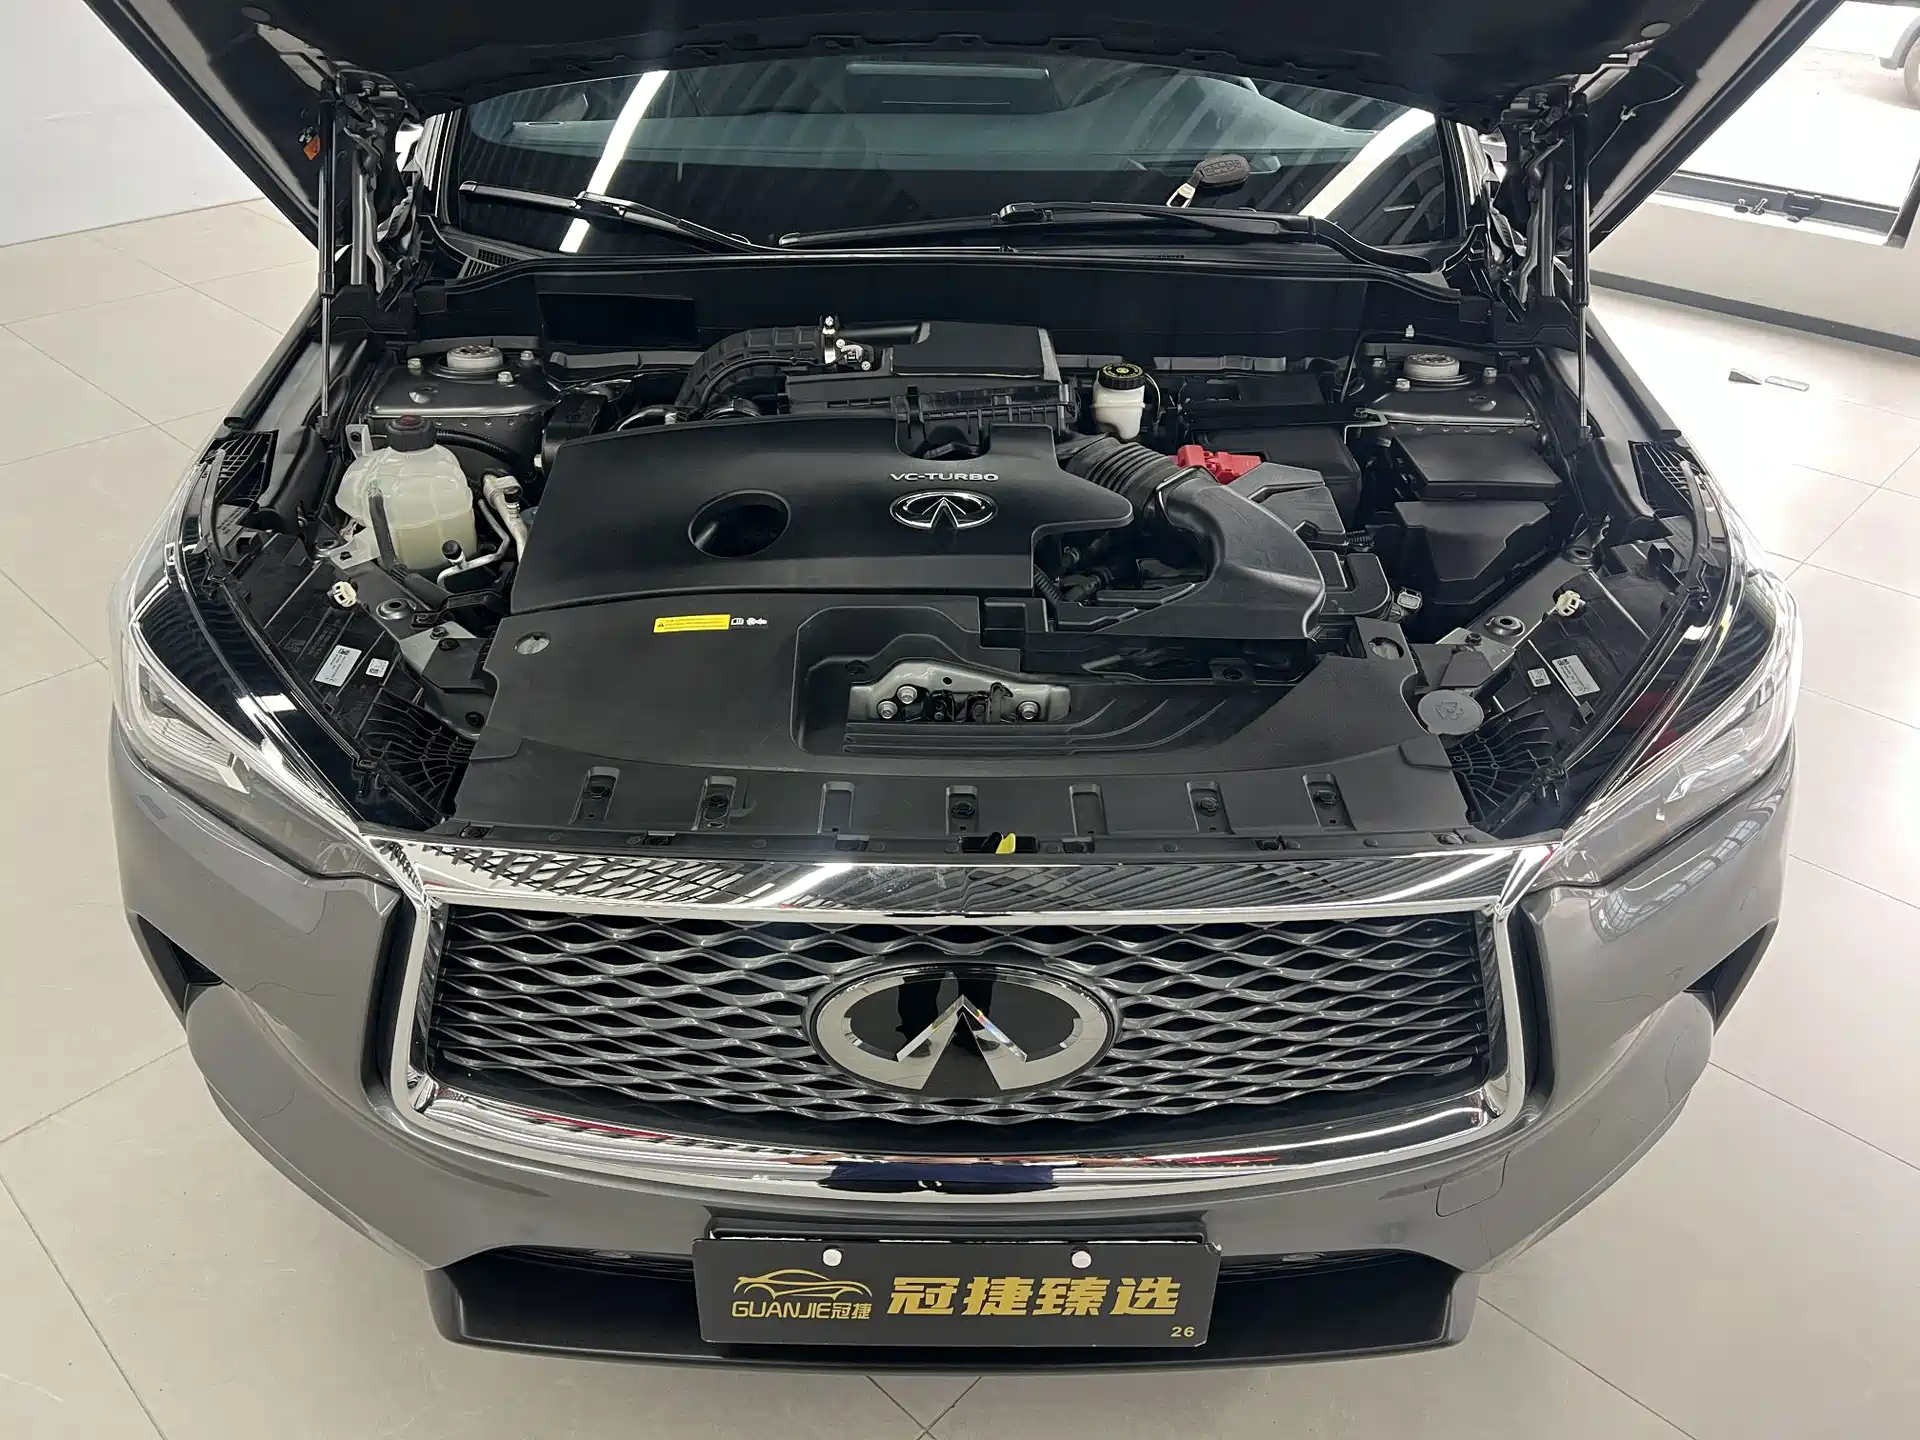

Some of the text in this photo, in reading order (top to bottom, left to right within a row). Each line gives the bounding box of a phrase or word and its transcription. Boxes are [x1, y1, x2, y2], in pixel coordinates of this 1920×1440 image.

[890, 472, 999, 481] VC-TURBO
[887, 1276, 1181, 1317] 冠捷臻选
[1170, 1326, 1195, 1337] 26
